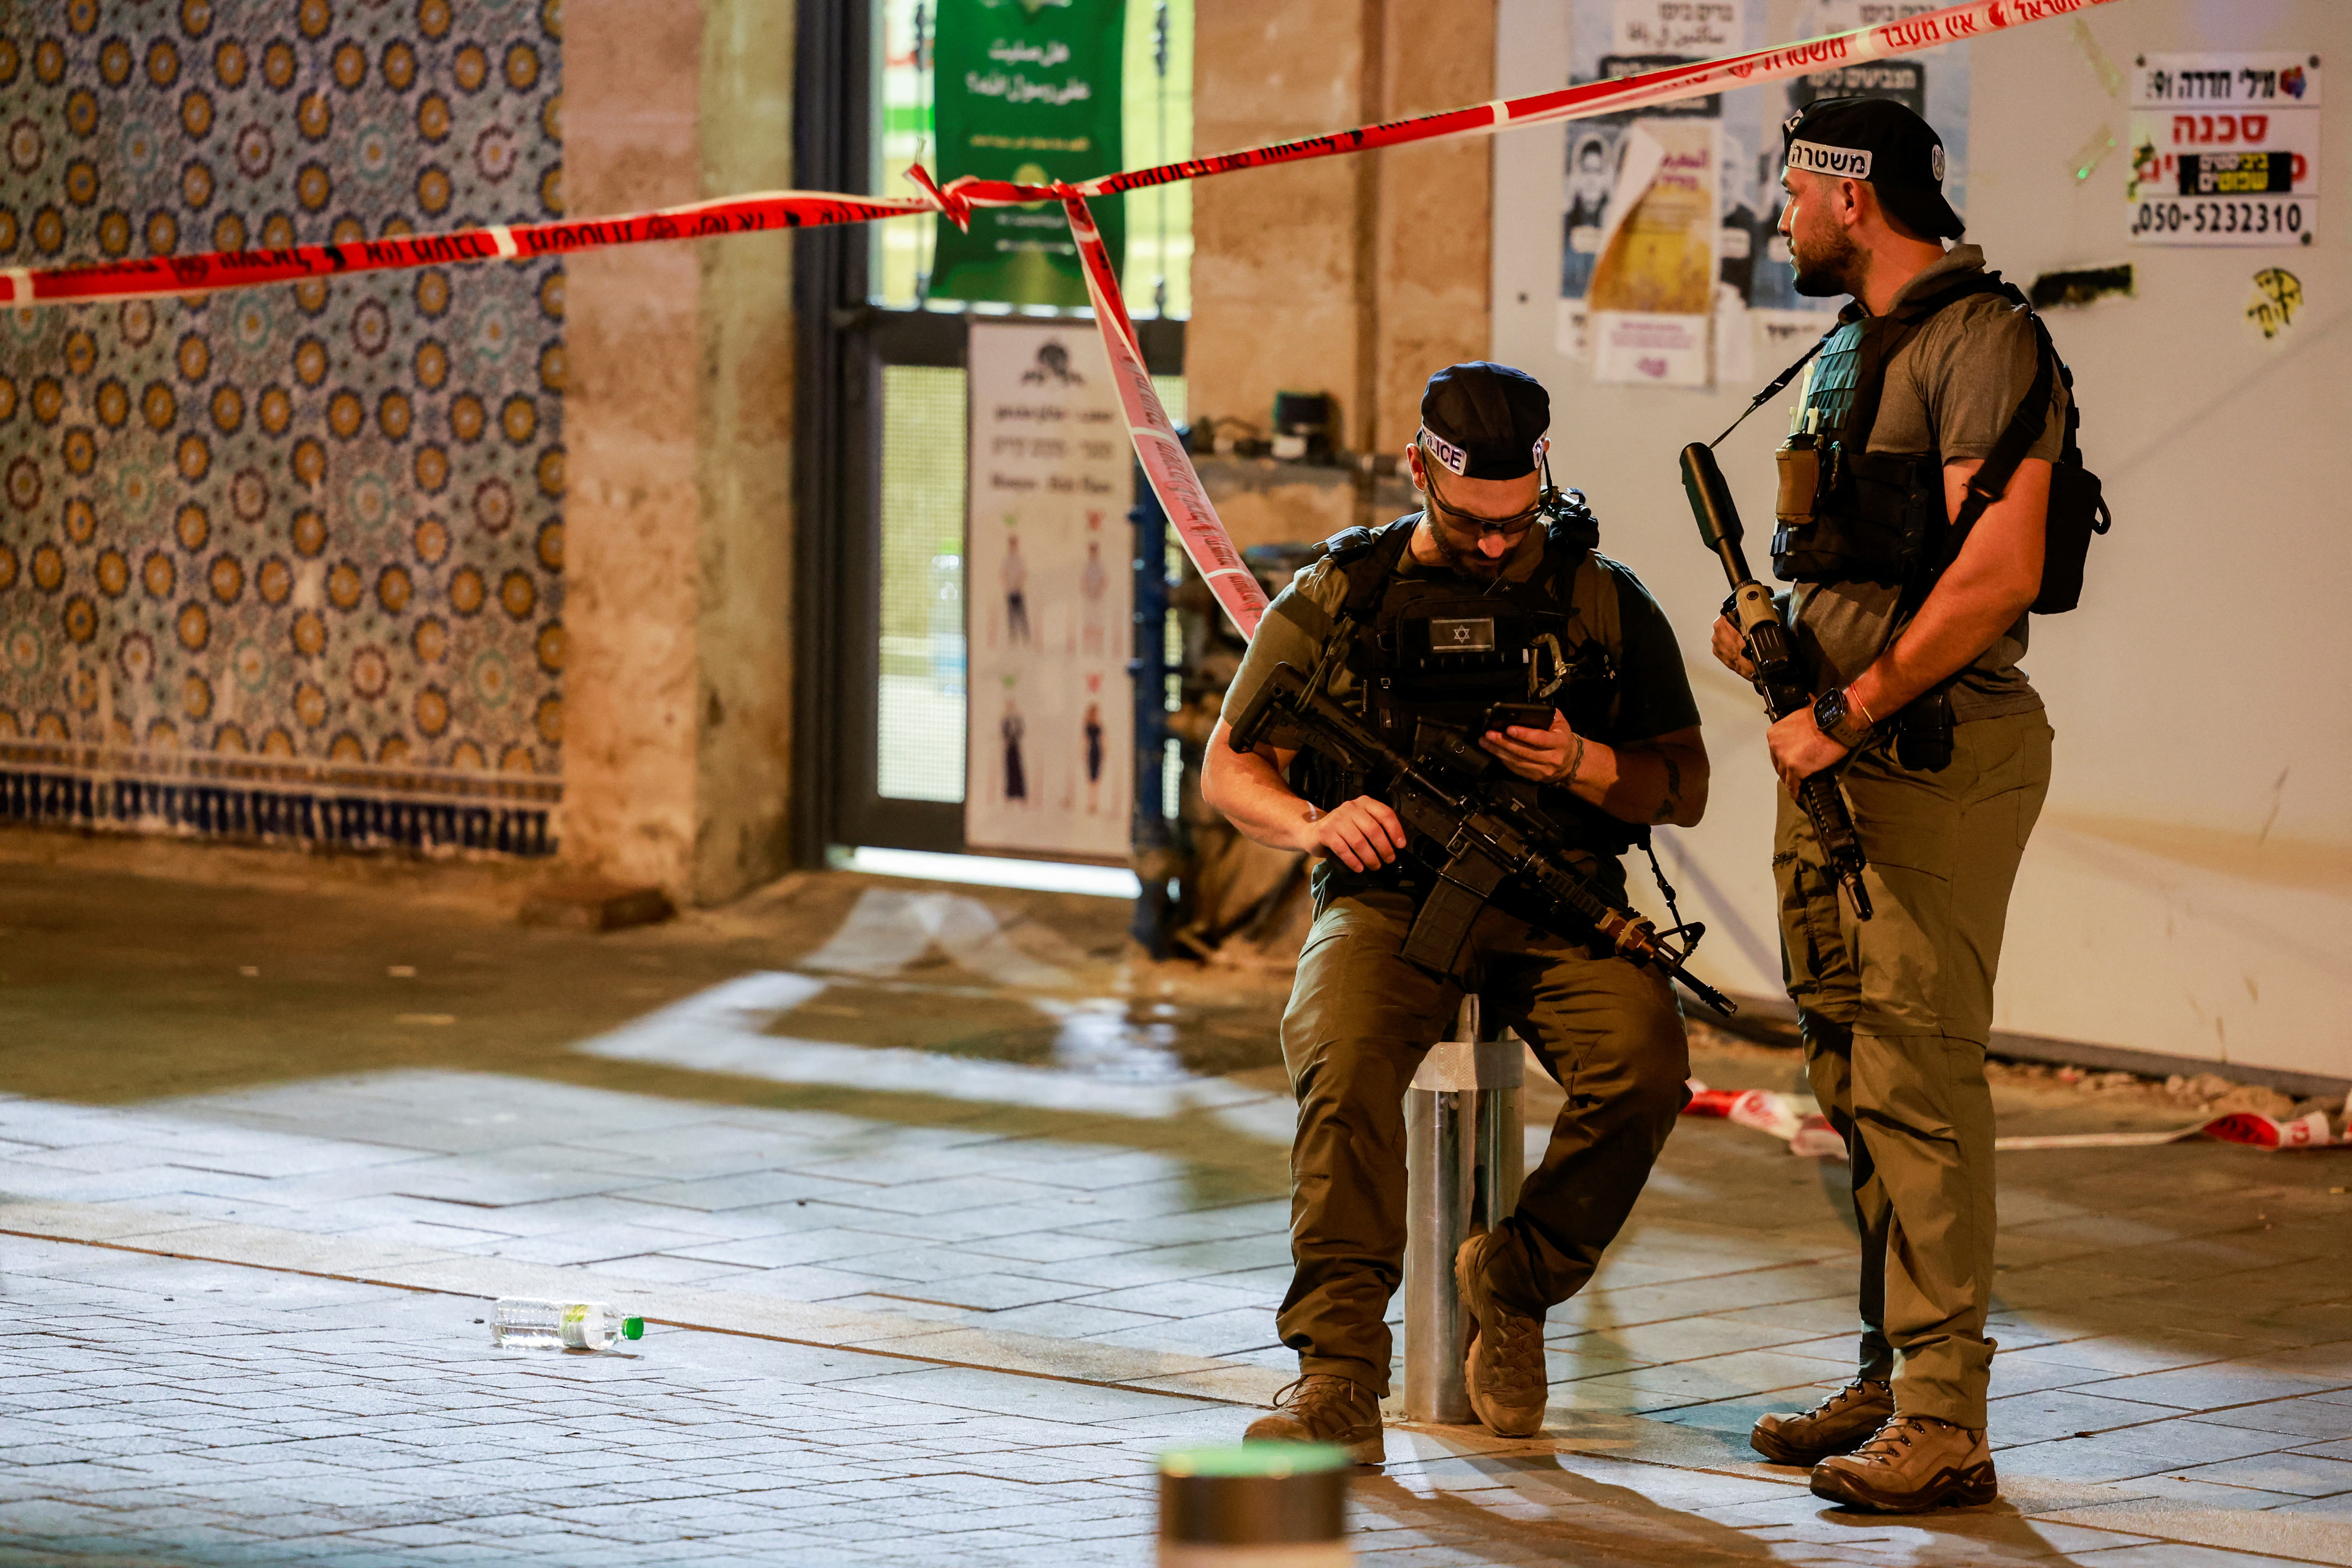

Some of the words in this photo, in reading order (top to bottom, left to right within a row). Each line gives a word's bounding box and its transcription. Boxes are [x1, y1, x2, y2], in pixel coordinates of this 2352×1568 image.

[1880, 20, 1940, 47] מעבר
[1946, 13, 1979, 38] אין
[2172, 115, 2268, 144] סכנה
[1792, 145, 1865, 173] משטרה
[2139, 203, 2302, 233] 050-5232310
